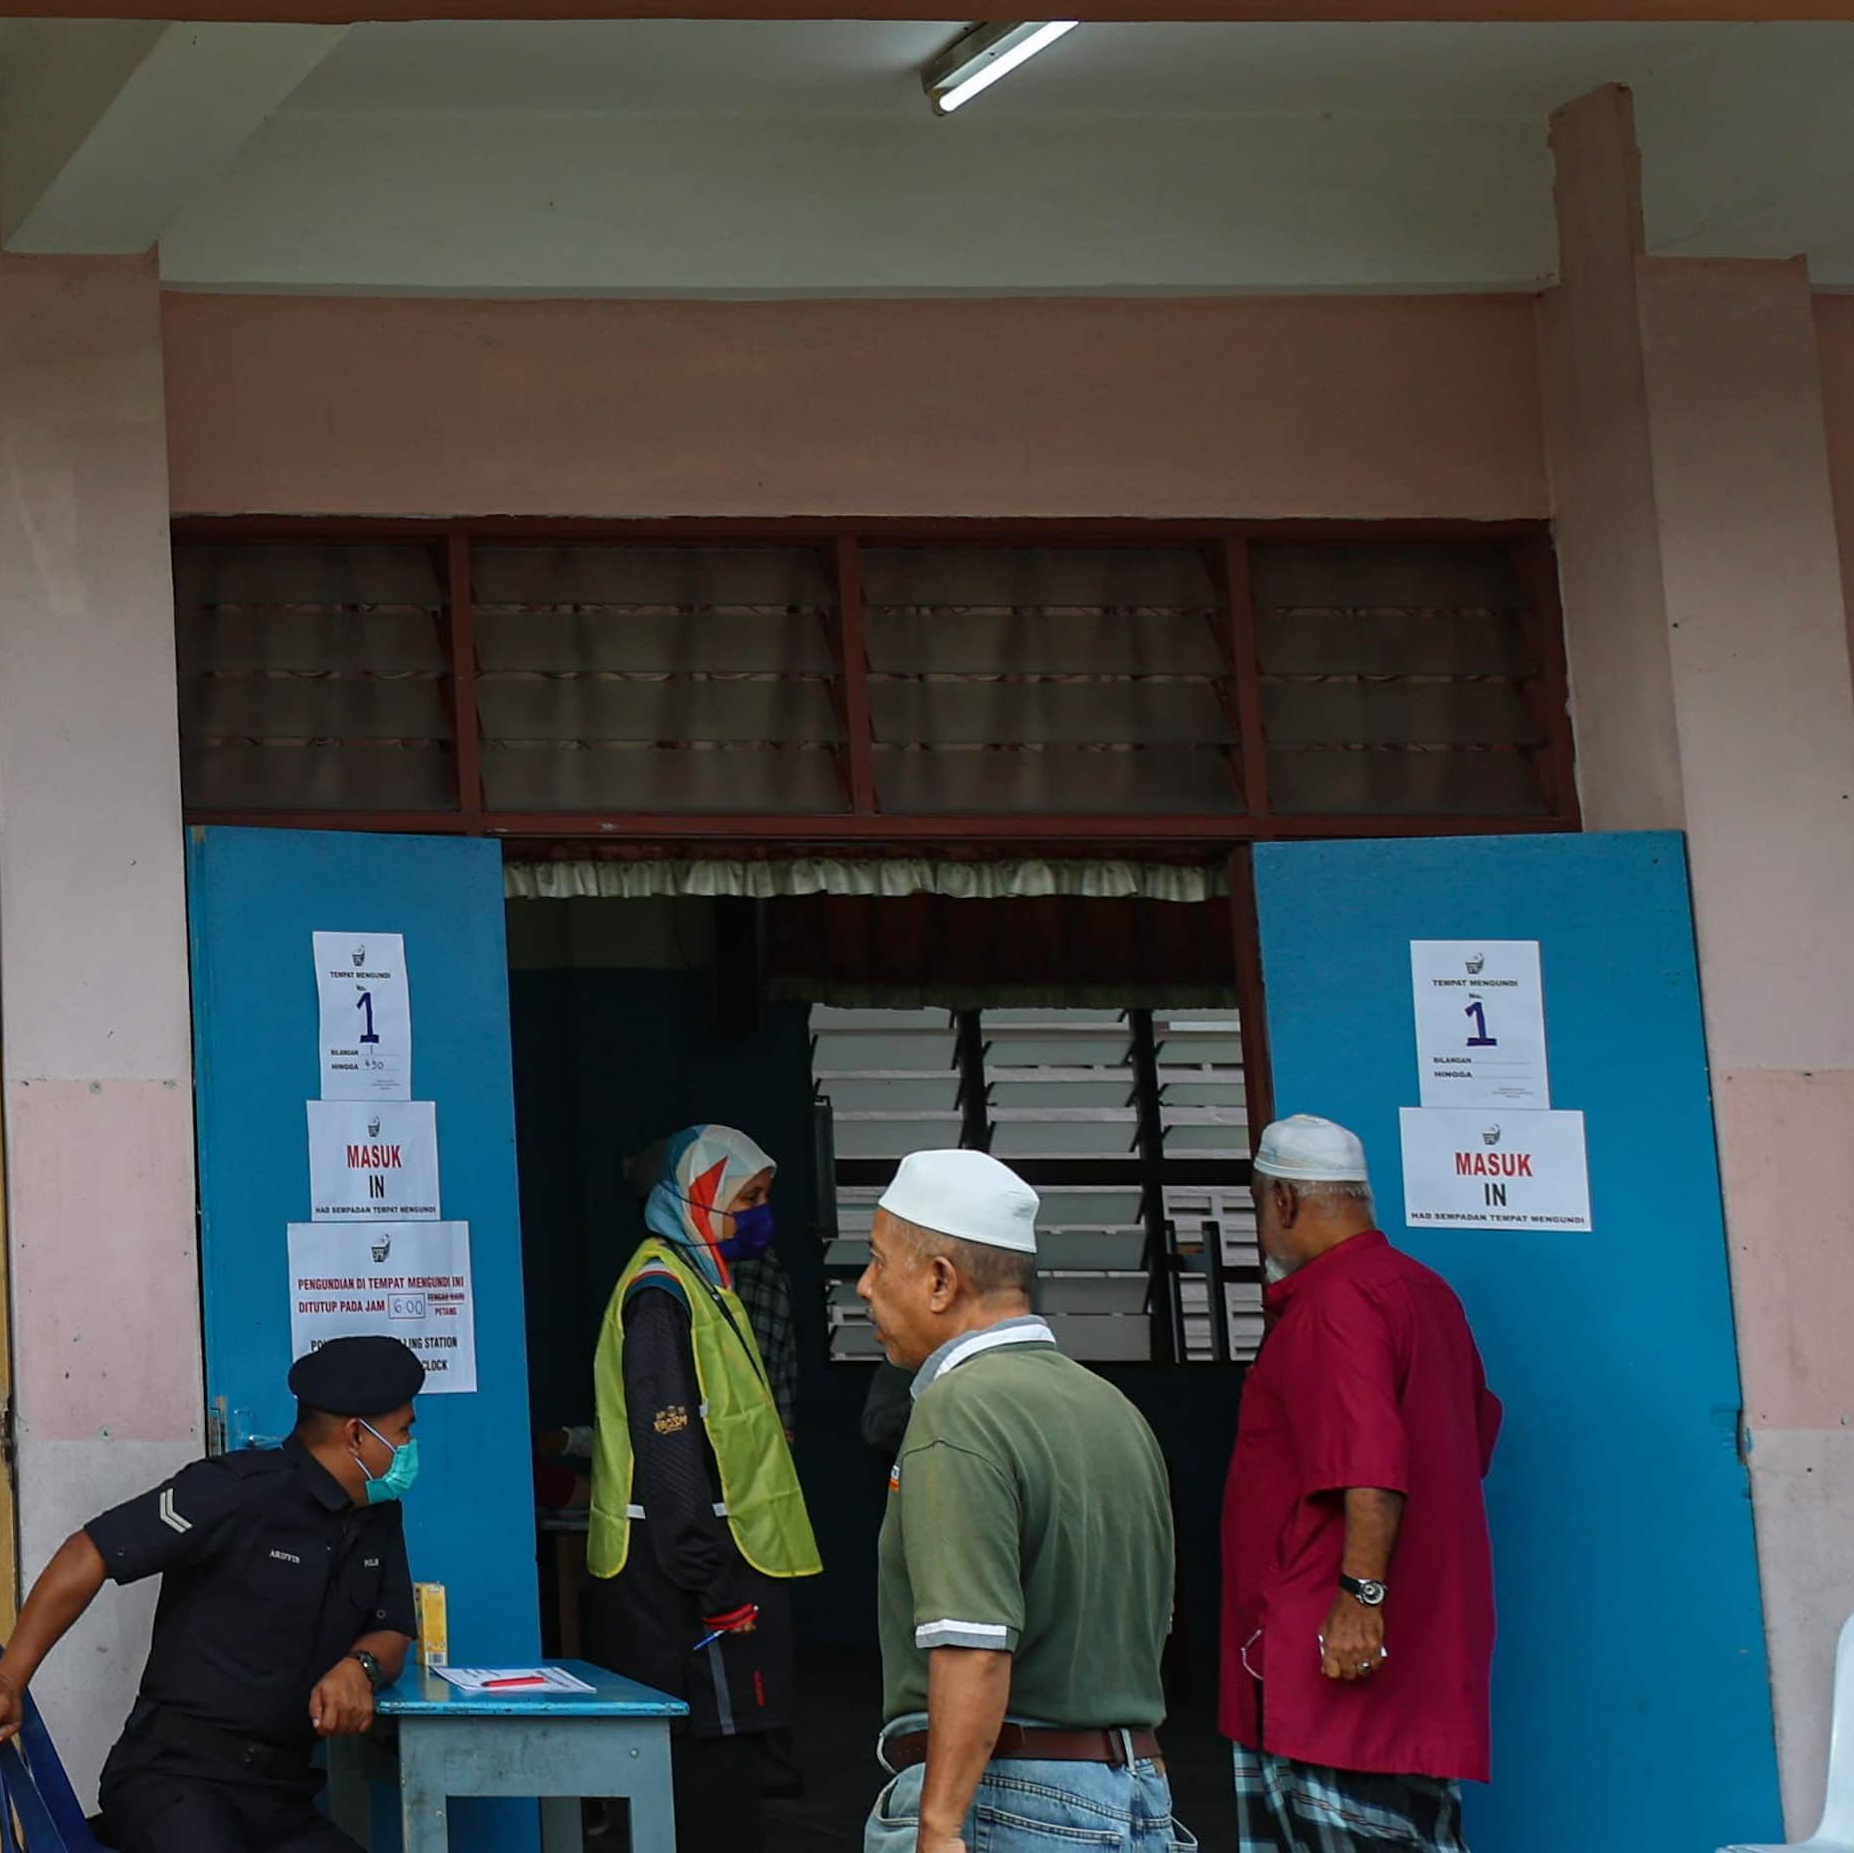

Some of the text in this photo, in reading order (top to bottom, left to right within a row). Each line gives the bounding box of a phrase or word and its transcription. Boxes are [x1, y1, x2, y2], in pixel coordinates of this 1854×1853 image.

[1432, 979, 1466, 987] TEMPAT
[356, 992, 380, 1043] 1
[1465, 1002, 1497, 1046] 1
[346, 1145, 402, 1168] MASUK
[1455, 1152, 1533, 1177] MASUK
[369, 1175, 384, 1198] IN
[1484, 1183, 1507, 1206] IN
[1411, 1212, 1585, 1224] HAD SEMPADAN TEMPAT MENGUNDI
[298, 1276, 464, 1290] PENGUNDIAN DI TEMPAT MENGUNDI INI
[299, 1300, 385, 1313] DITUTUP PADA JAM
[424, 1336, 458, 1348] STATION
